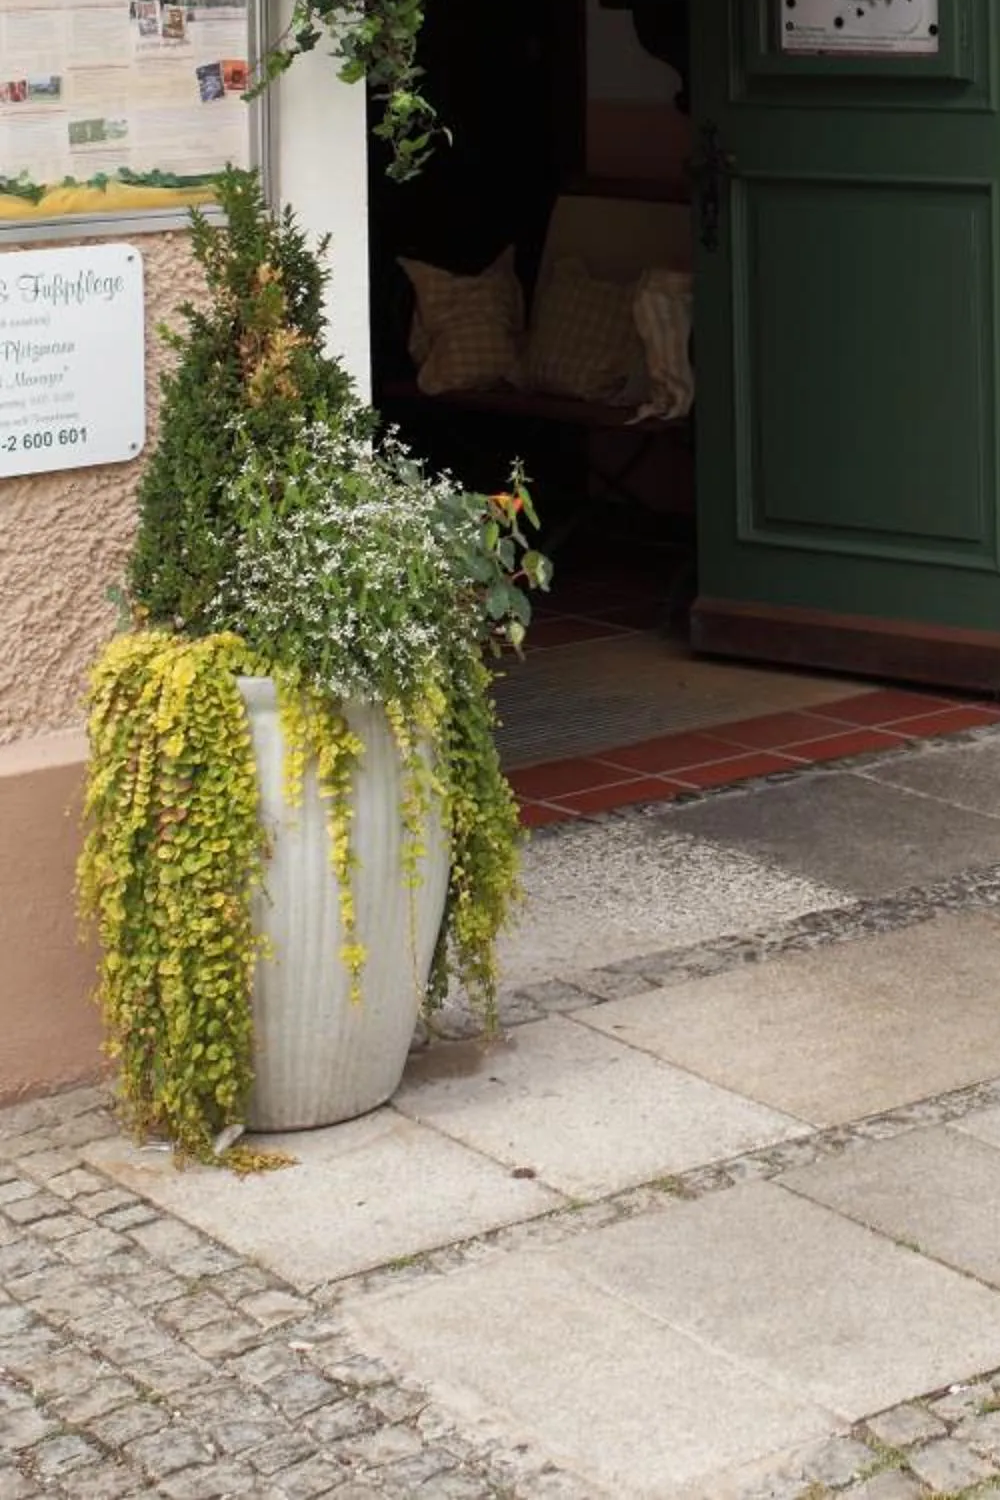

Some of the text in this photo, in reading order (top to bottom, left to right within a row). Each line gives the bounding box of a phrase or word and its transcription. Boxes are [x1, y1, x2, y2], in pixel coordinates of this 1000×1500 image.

[16, 269, 125, 306] Fußpflege
[23, 430, 54, 450] 600
[59, 427, 87, 446] 601
